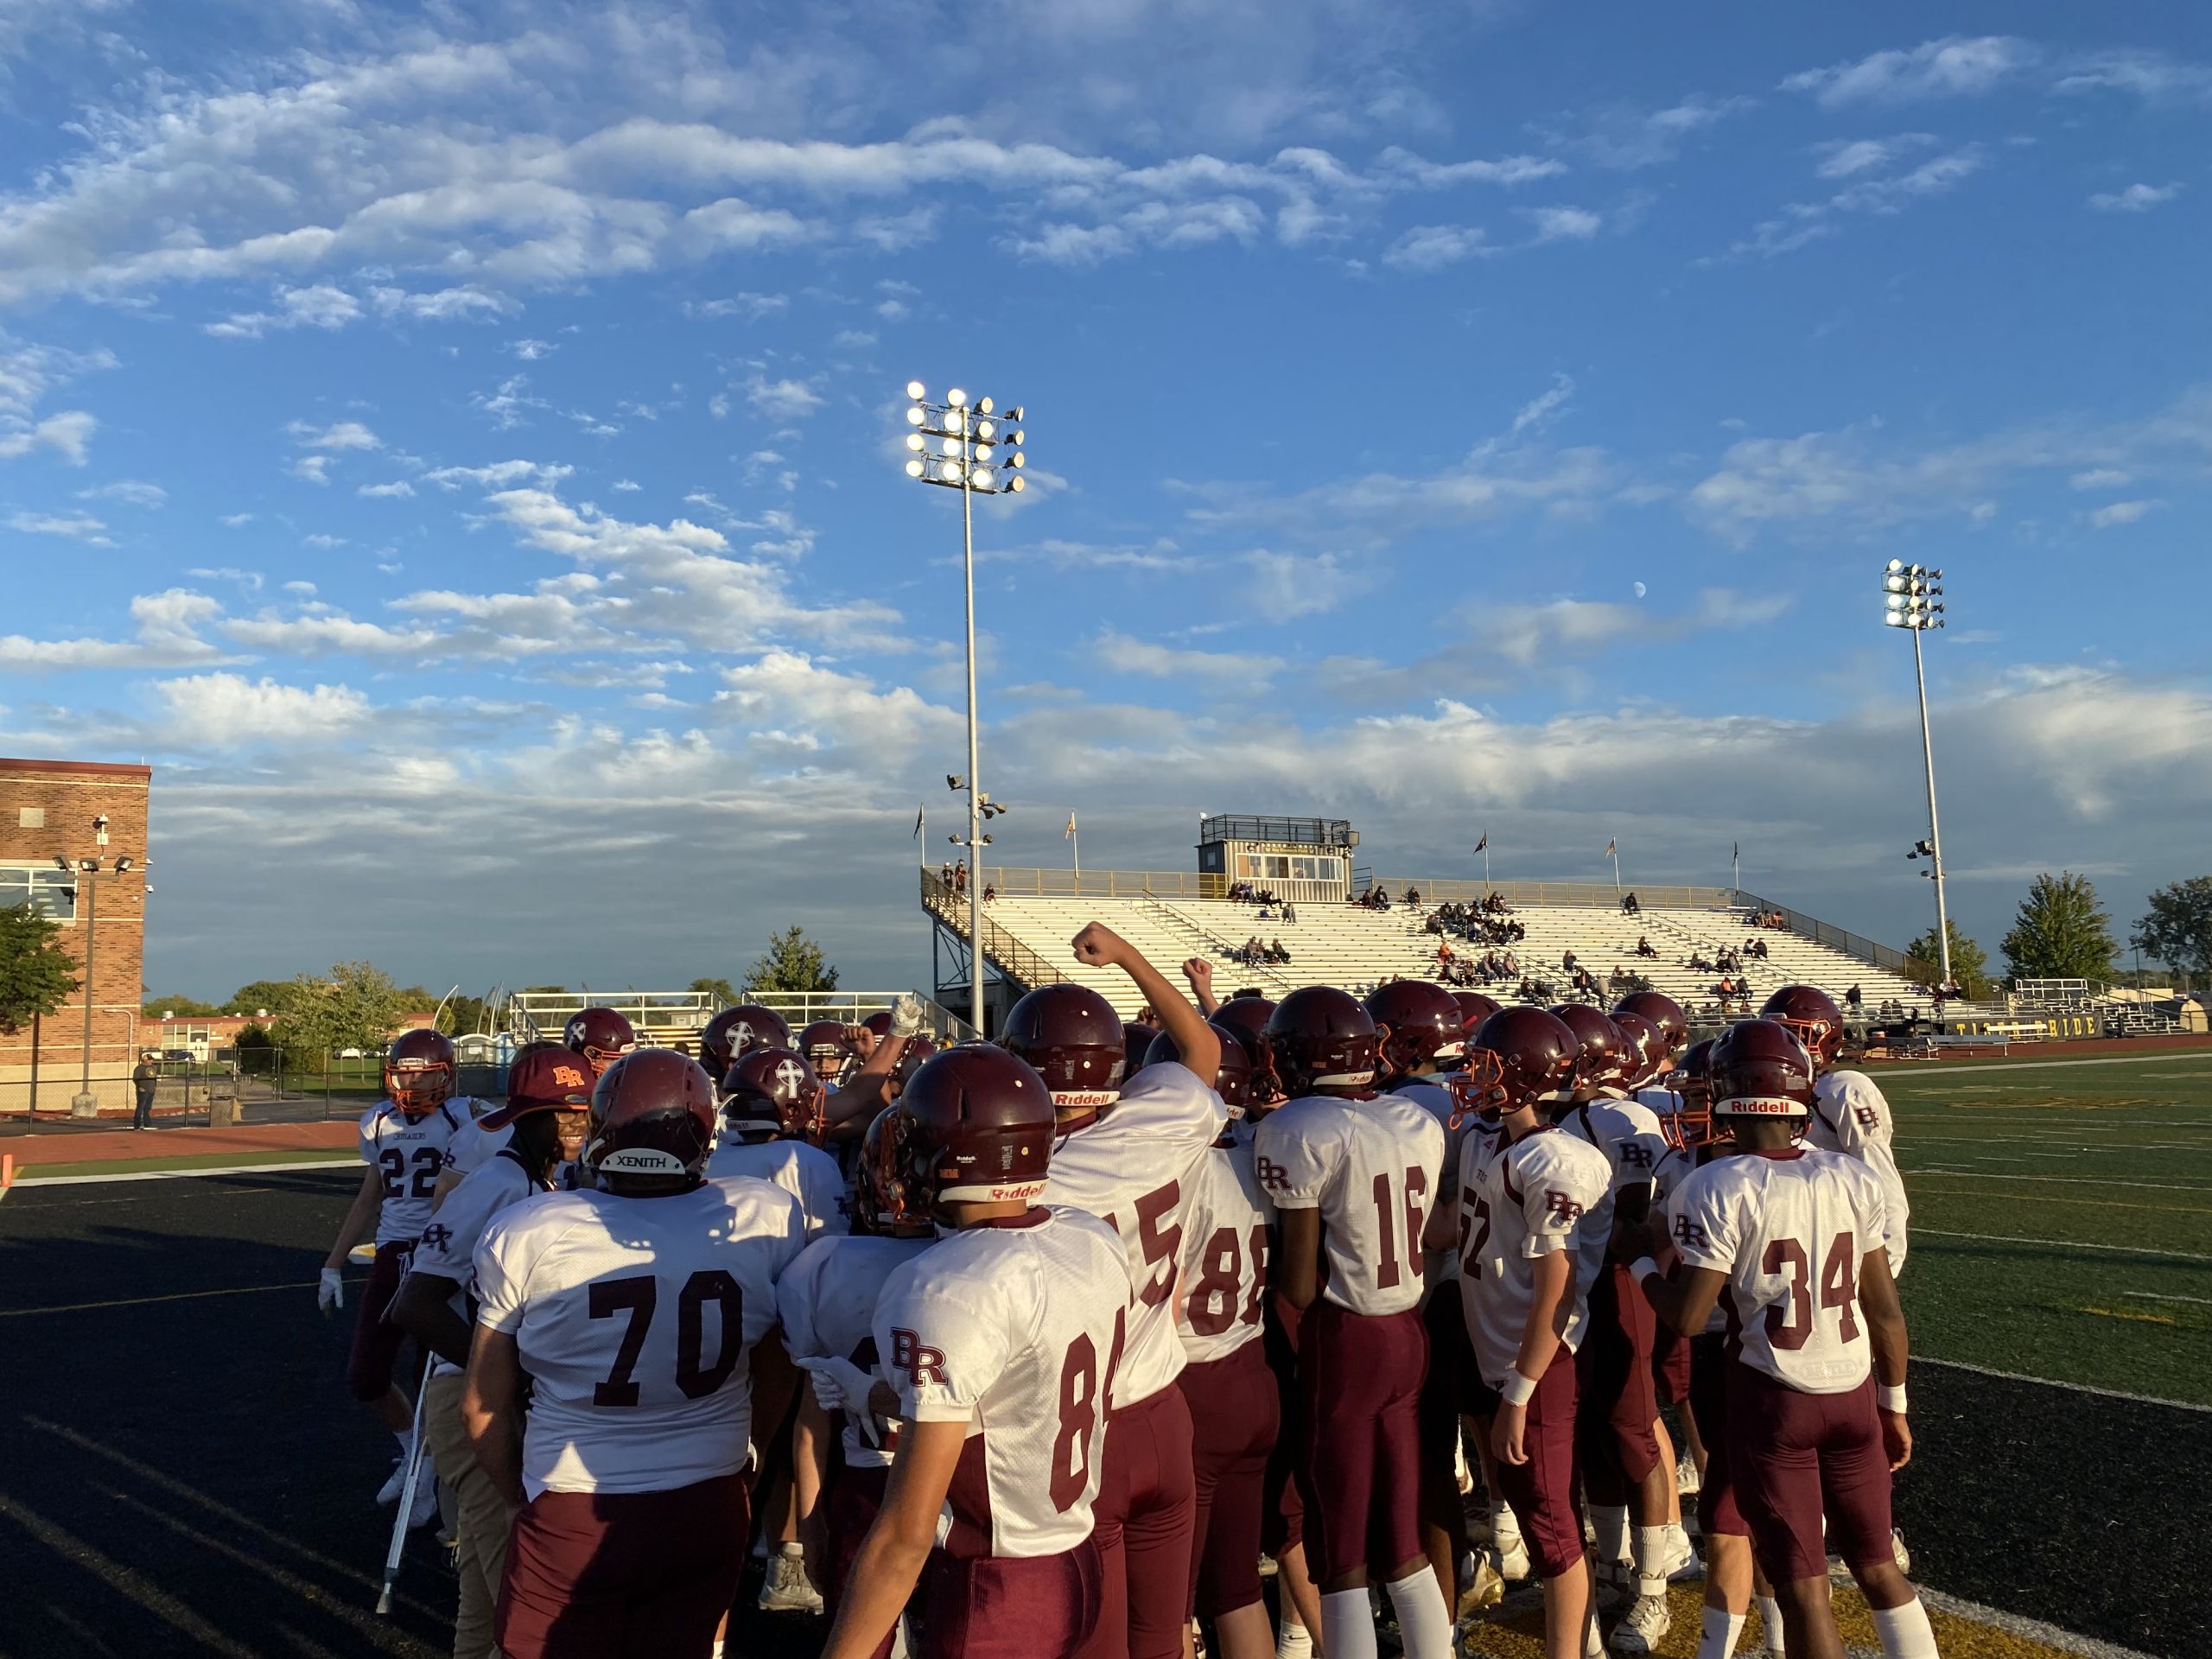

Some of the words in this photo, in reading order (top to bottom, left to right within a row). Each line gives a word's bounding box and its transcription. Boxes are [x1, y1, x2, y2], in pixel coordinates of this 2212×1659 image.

[553, 1065, 585, 1087] BR
[1055, 1094, 1109, 1105] Riddell
[1731, 1100, 1789, 1114] Riddell
[379, 1147, 442, 1198] 22
[616, 1155, 667, 1168] XENITH
[1256, 1154, 1293, 1191] BR
[1619, 1142, 1654, 1168] BR
[991, 1183, 1047, 1200] Riddell
[1373, 1166, 1427, 1289] 16
[1674, 1212, 1711, 1250] BR
[1762, 1231, 1860, 1351] 34
[588, 1269, 743, 1407] 70
[890, 1326, 948, 1388] BR
